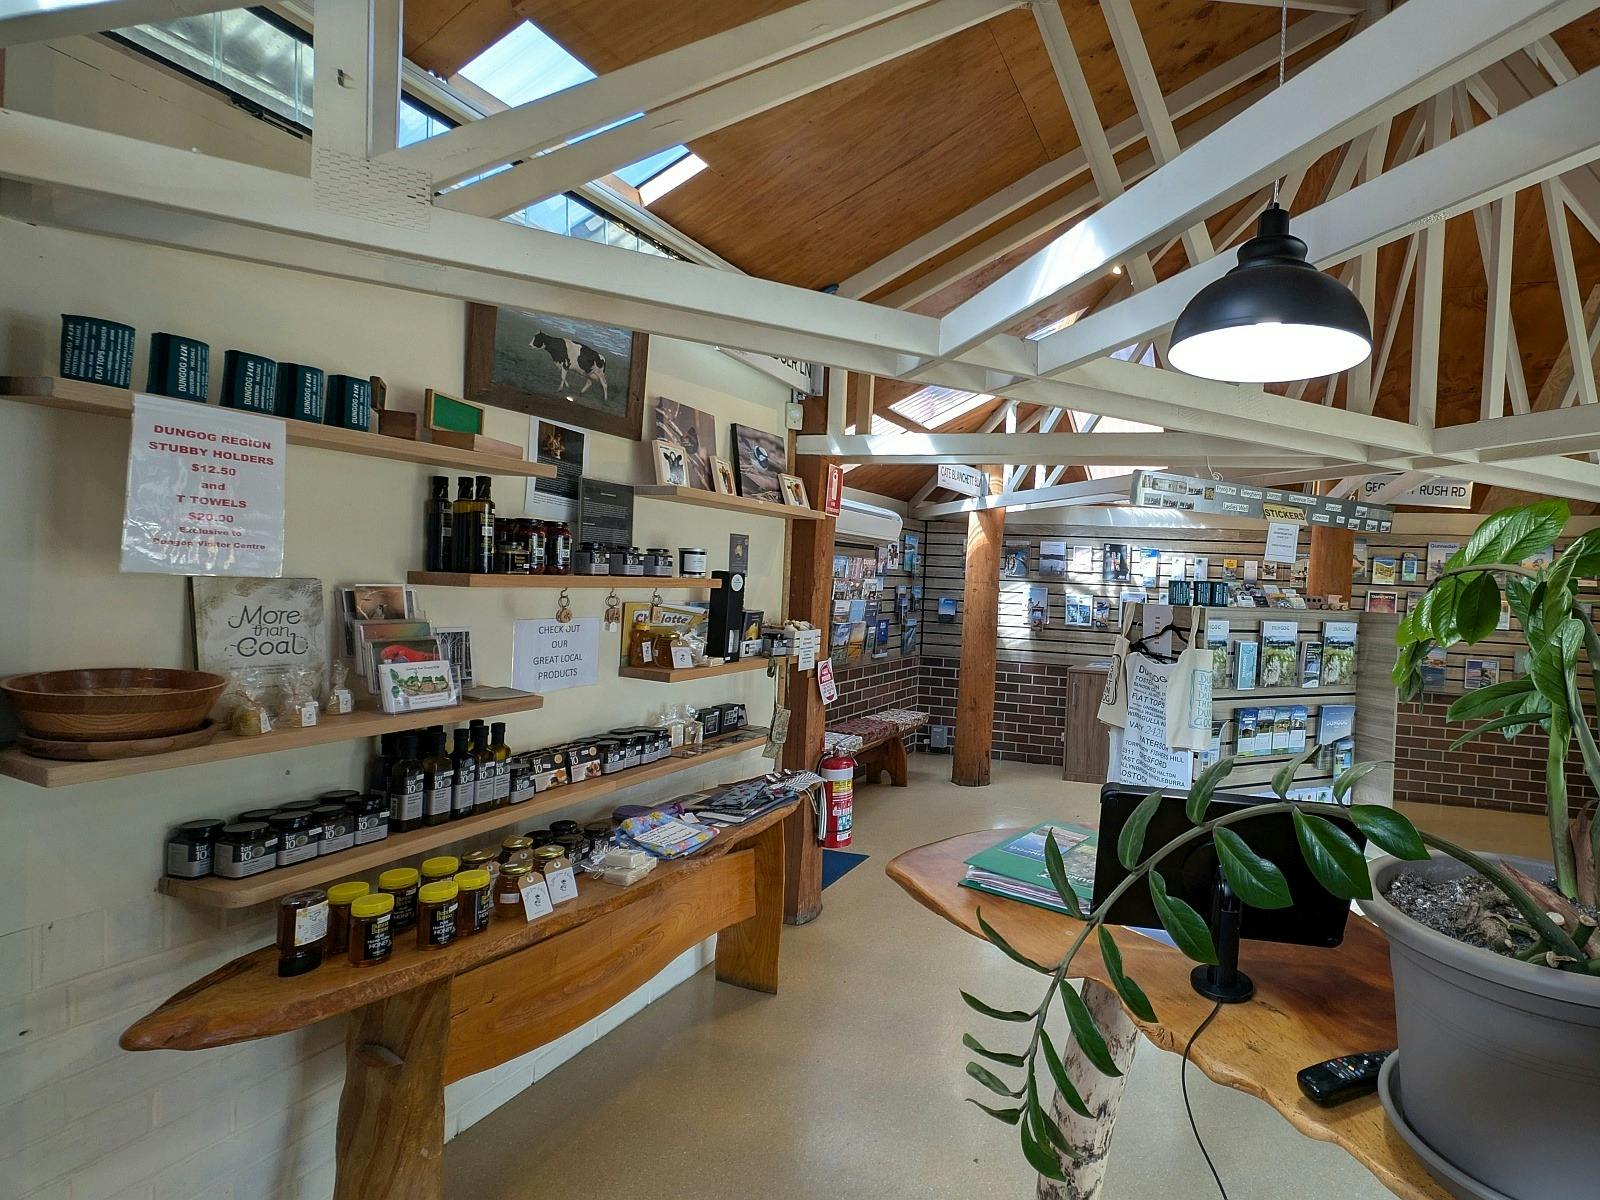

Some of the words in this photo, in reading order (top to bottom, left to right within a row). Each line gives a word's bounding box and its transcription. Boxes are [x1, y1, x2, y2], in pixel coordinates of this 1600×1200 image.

[64, 342, 73, 373] DUNGOG
[178, 362, 188, 392] DUNGOG
[244, 377, 253, 405] DUNGOG
[303, 388, 312, 414] DUNGOG
[153, 424, 217, 442] DUNGOG
[221, 435, 272, 450] REGION
[148, 441, 208, 457] STUBBY
[212, 450, 274, 466] HOLDERS
[191, 463, 236, 476] $12.50
[941, 466, 952, 479] CATE
[952, 469, 974, 486] BLANCHETT
[201, 481, 226, 491] and
[1419, 485, 1448, 496] RUSH
[1451, 486, 1466, 497] RD
[176, 494, 186, 503] T
[190, 495, 247, 508] TOWELS
[188, 512, 234, 523] $20.00
[1264, 508, 1305, 521] STICKERS
[179, 526, 229, 536] Exclusive
[233, 542, 266, 550] Centre
[228, 605, 301, 629] More
[635, 613, 689, 624] Chlotte
[251, 624, 290, 637] than
[538, 625, 564, 635] CHECK
[565, 624, 581, 633] OUT
[237, 633, 309, 657] Coal
[551, 640, 568, 649] OUR
[532, 655, 559, 665] GREAT
[560, 653, 583, 663] LOCAL
[537, 668, 578, 680] PRODUCTS
[1132, 692, 1148, 703] FLAT
[1149, 698, 1165, 709] TOPS
[1144, 725, 1163, 738] 2421
[569, 757, 578, 765] 10
[1169, 755, 1185, 764] HILL
[479, 771, 487, 779] 10
[496, 767, 504, 775] 10
[533, 765, 542, 774] 10
[1157, 770, 1177, 779] HALTON
[434, 781, 443, 789] 10
[460, 776, 468, 784] 10
[407, 785, 416, 794] 10
[358, 822, 368, 831] 10
[325, 831, 336, 839] 10
[285, 840, 297, 850] 10
[195, 852, 207, 861] 10
[240, 852, 253, 862] 10
